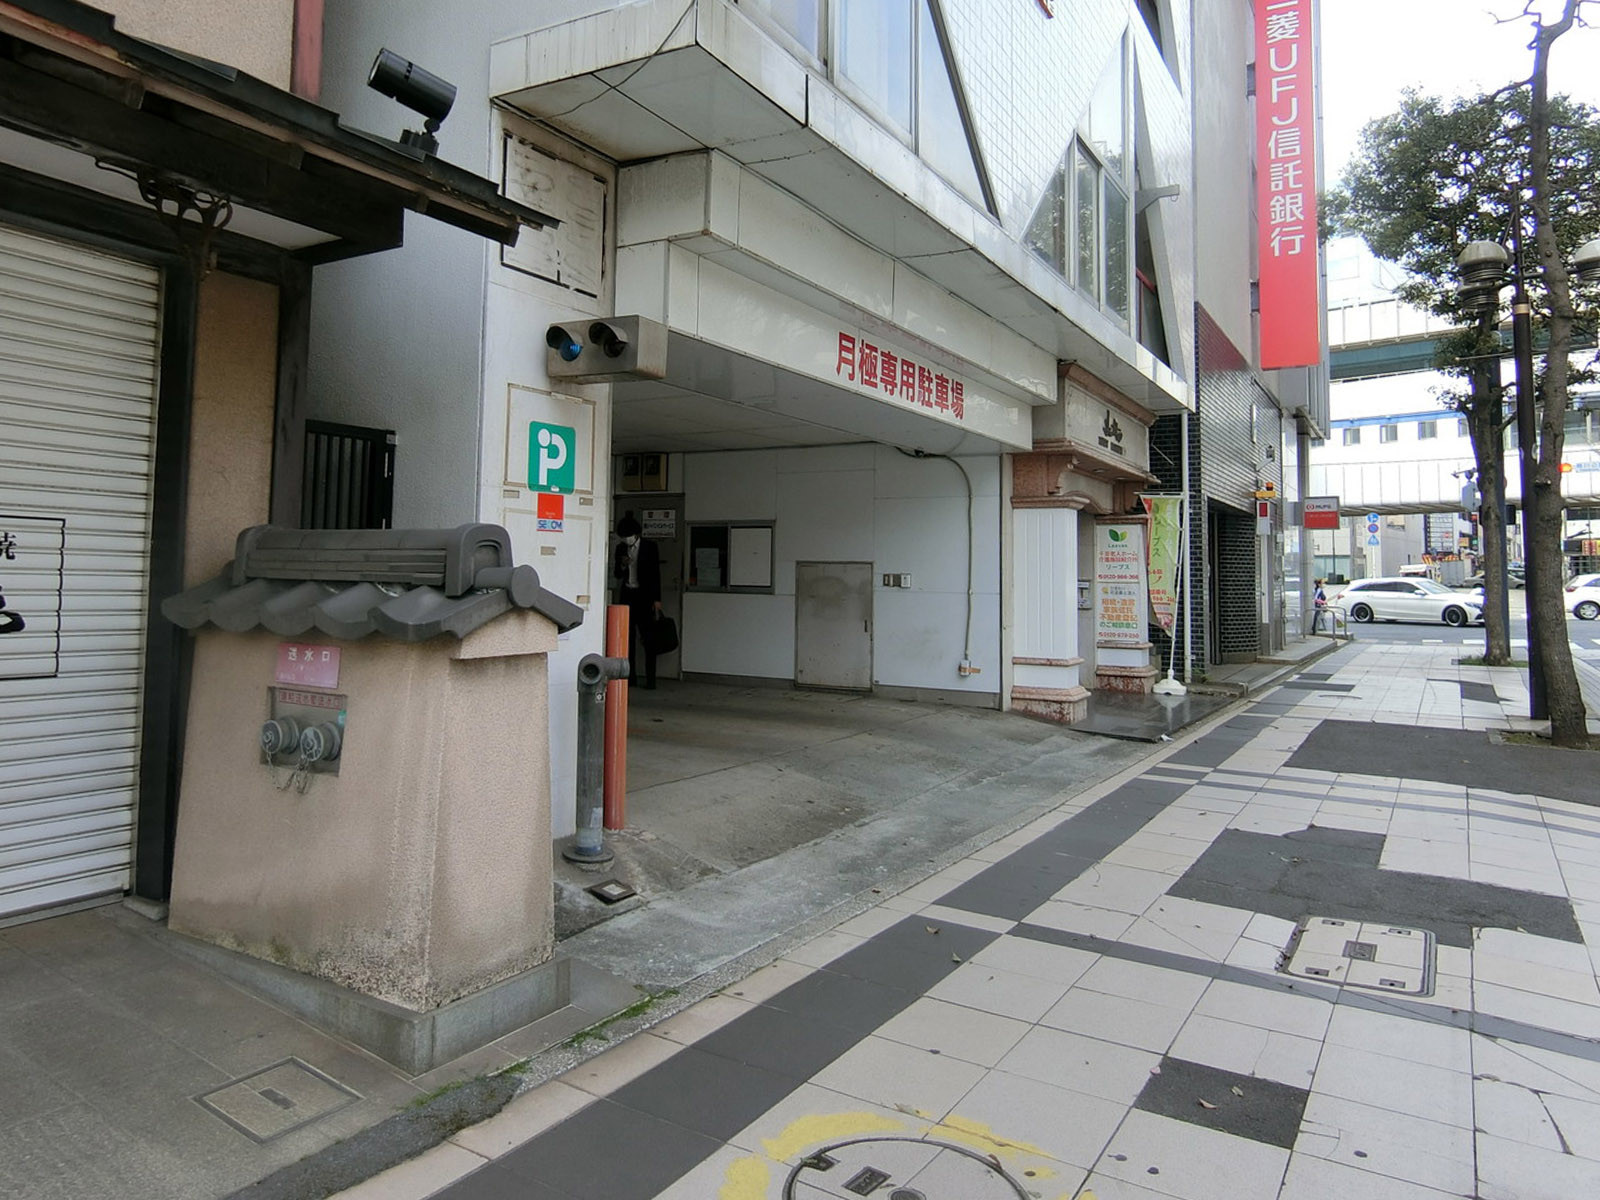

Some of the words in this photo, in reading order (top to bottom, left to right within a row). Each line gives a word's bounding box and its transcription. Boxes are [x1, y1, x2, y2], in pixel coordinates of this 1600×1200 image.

[836, 331, 964, 420] 月極専用駐車場
